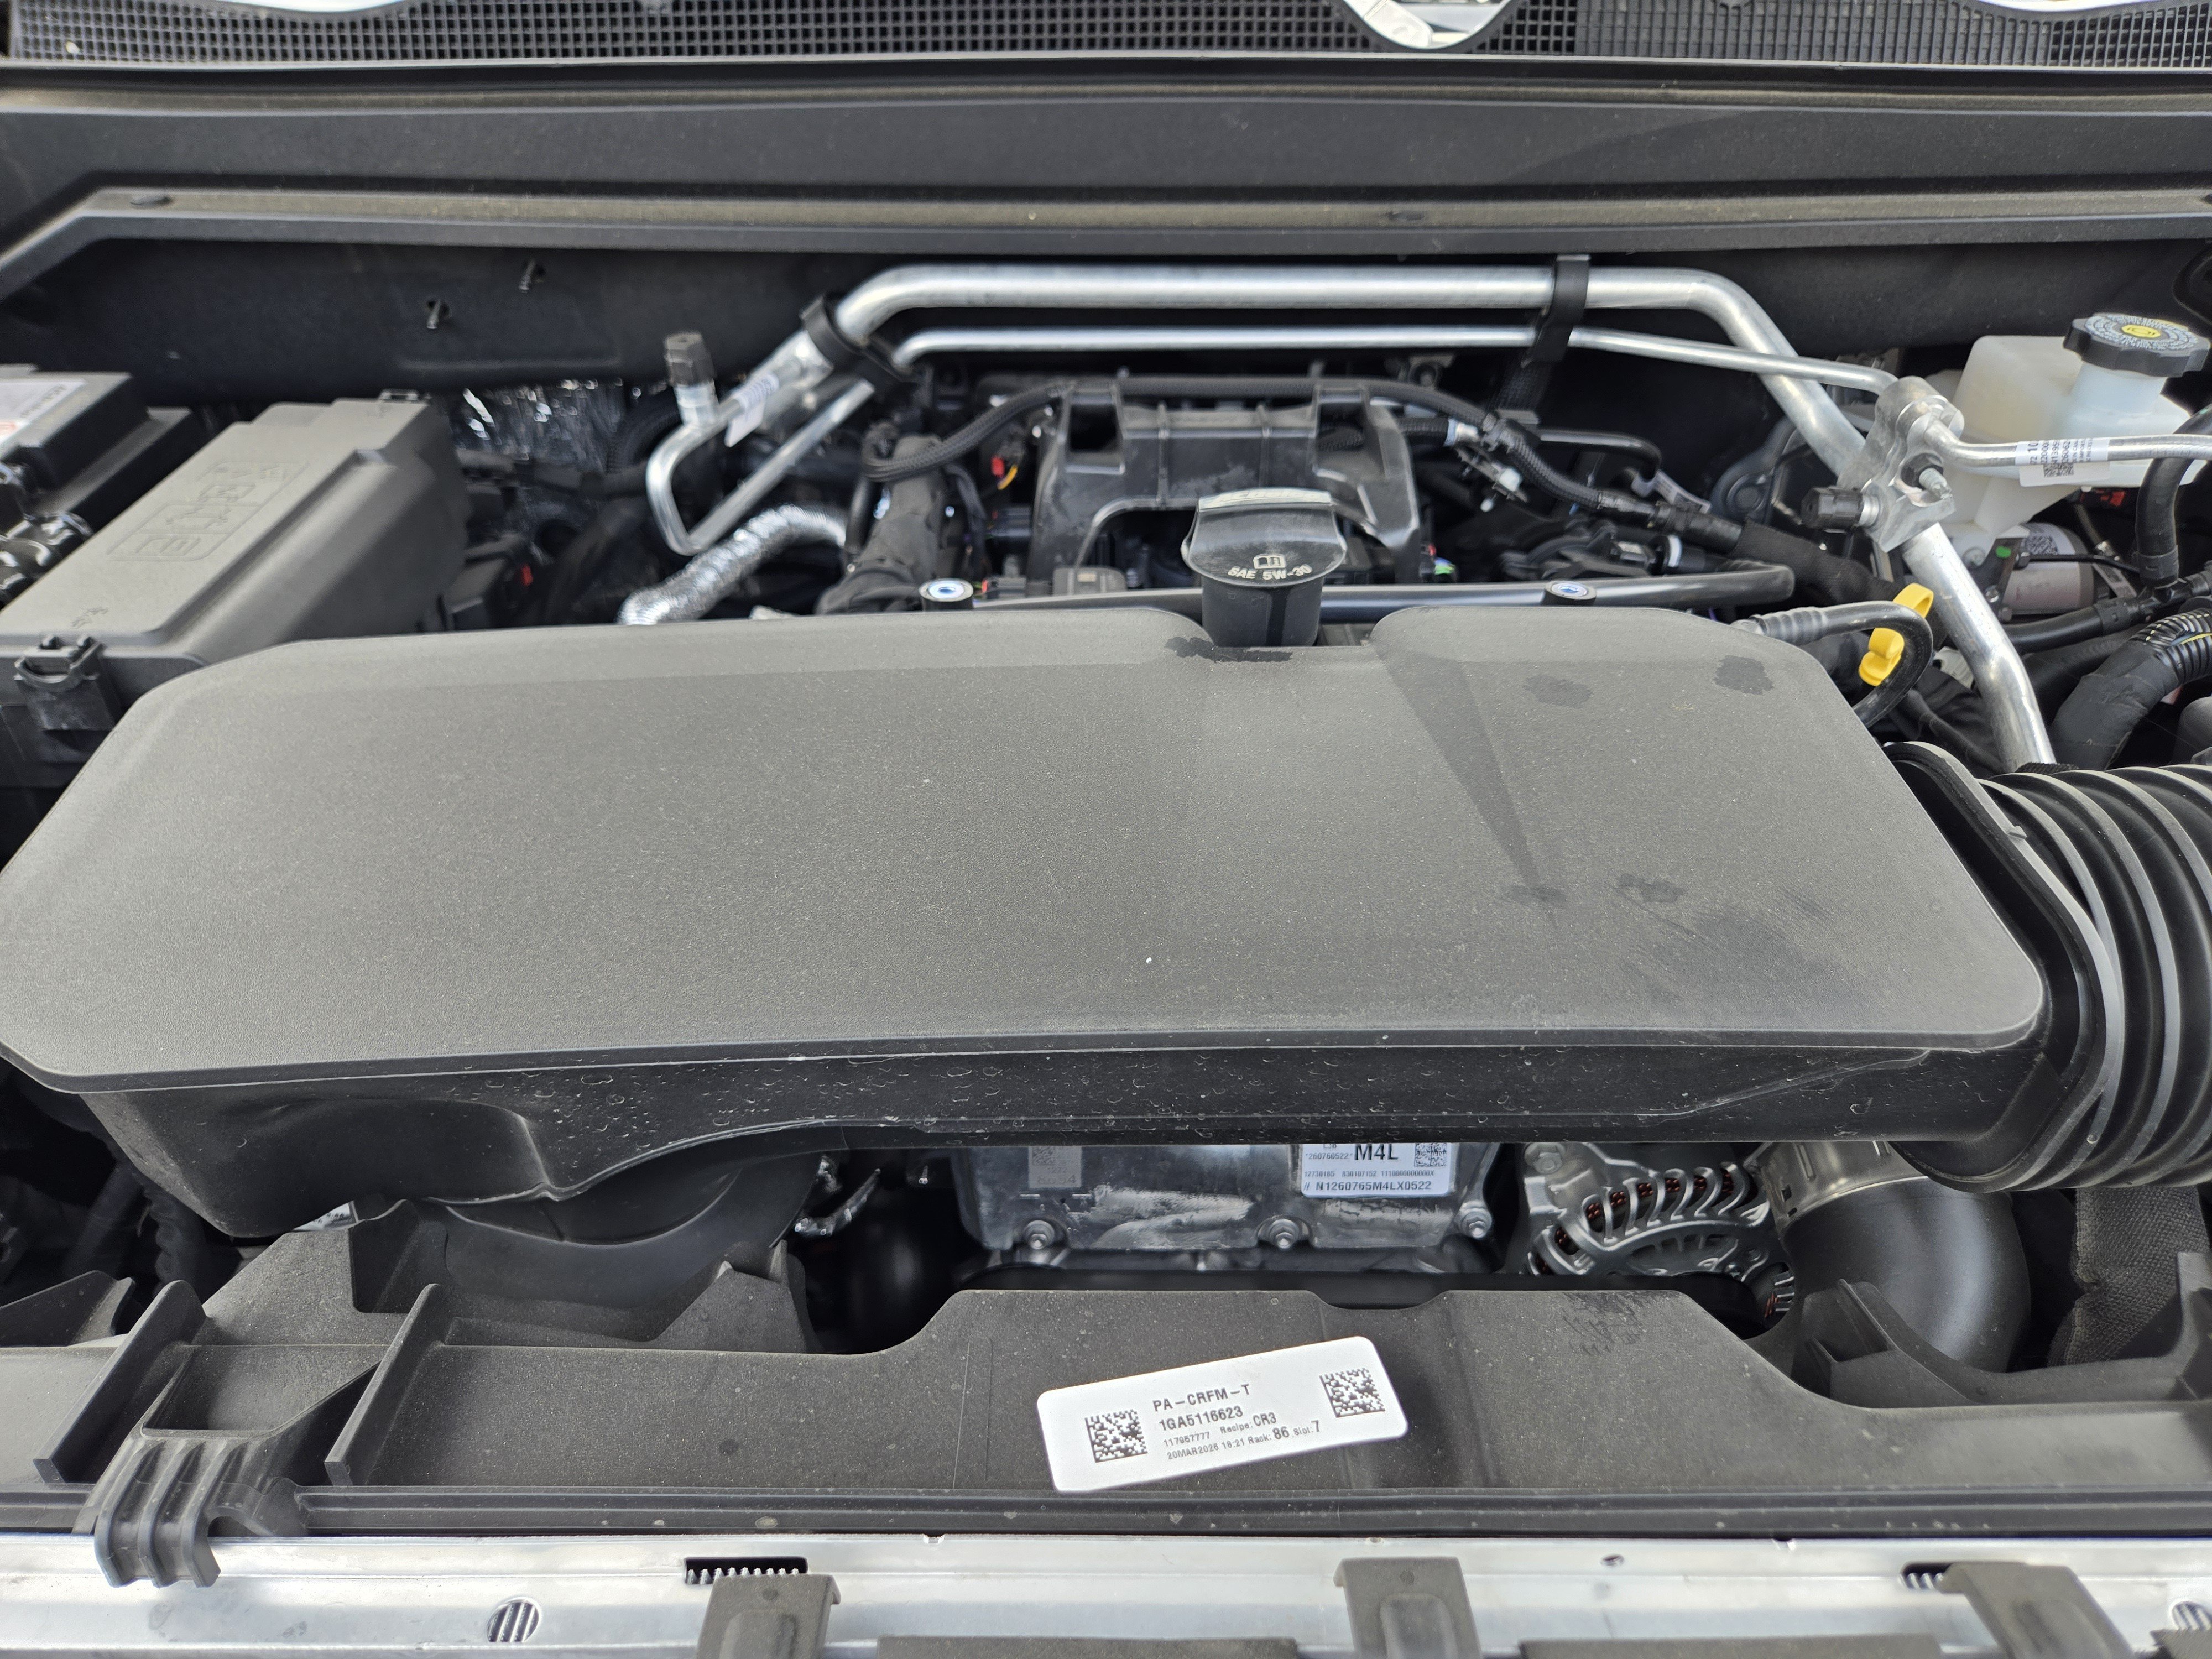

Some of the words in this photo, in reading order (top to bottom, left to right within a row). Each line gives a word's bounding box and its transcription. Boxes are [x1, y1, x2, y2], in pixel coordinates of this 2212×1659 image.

[1227, 565, 1257, 580] SAE
[1262, 564, 1313, 580] 5W-30
[1354, 1143, 1399, 1160] M4L
[1159, 1405, 1243, 1431] 1GA5116623
[1167, 1443, 1219, 1459] 20MAR2026
[1222, 1438, 1245, 1449] 18:21
[1272, 1426, 1290, 1439] 86
